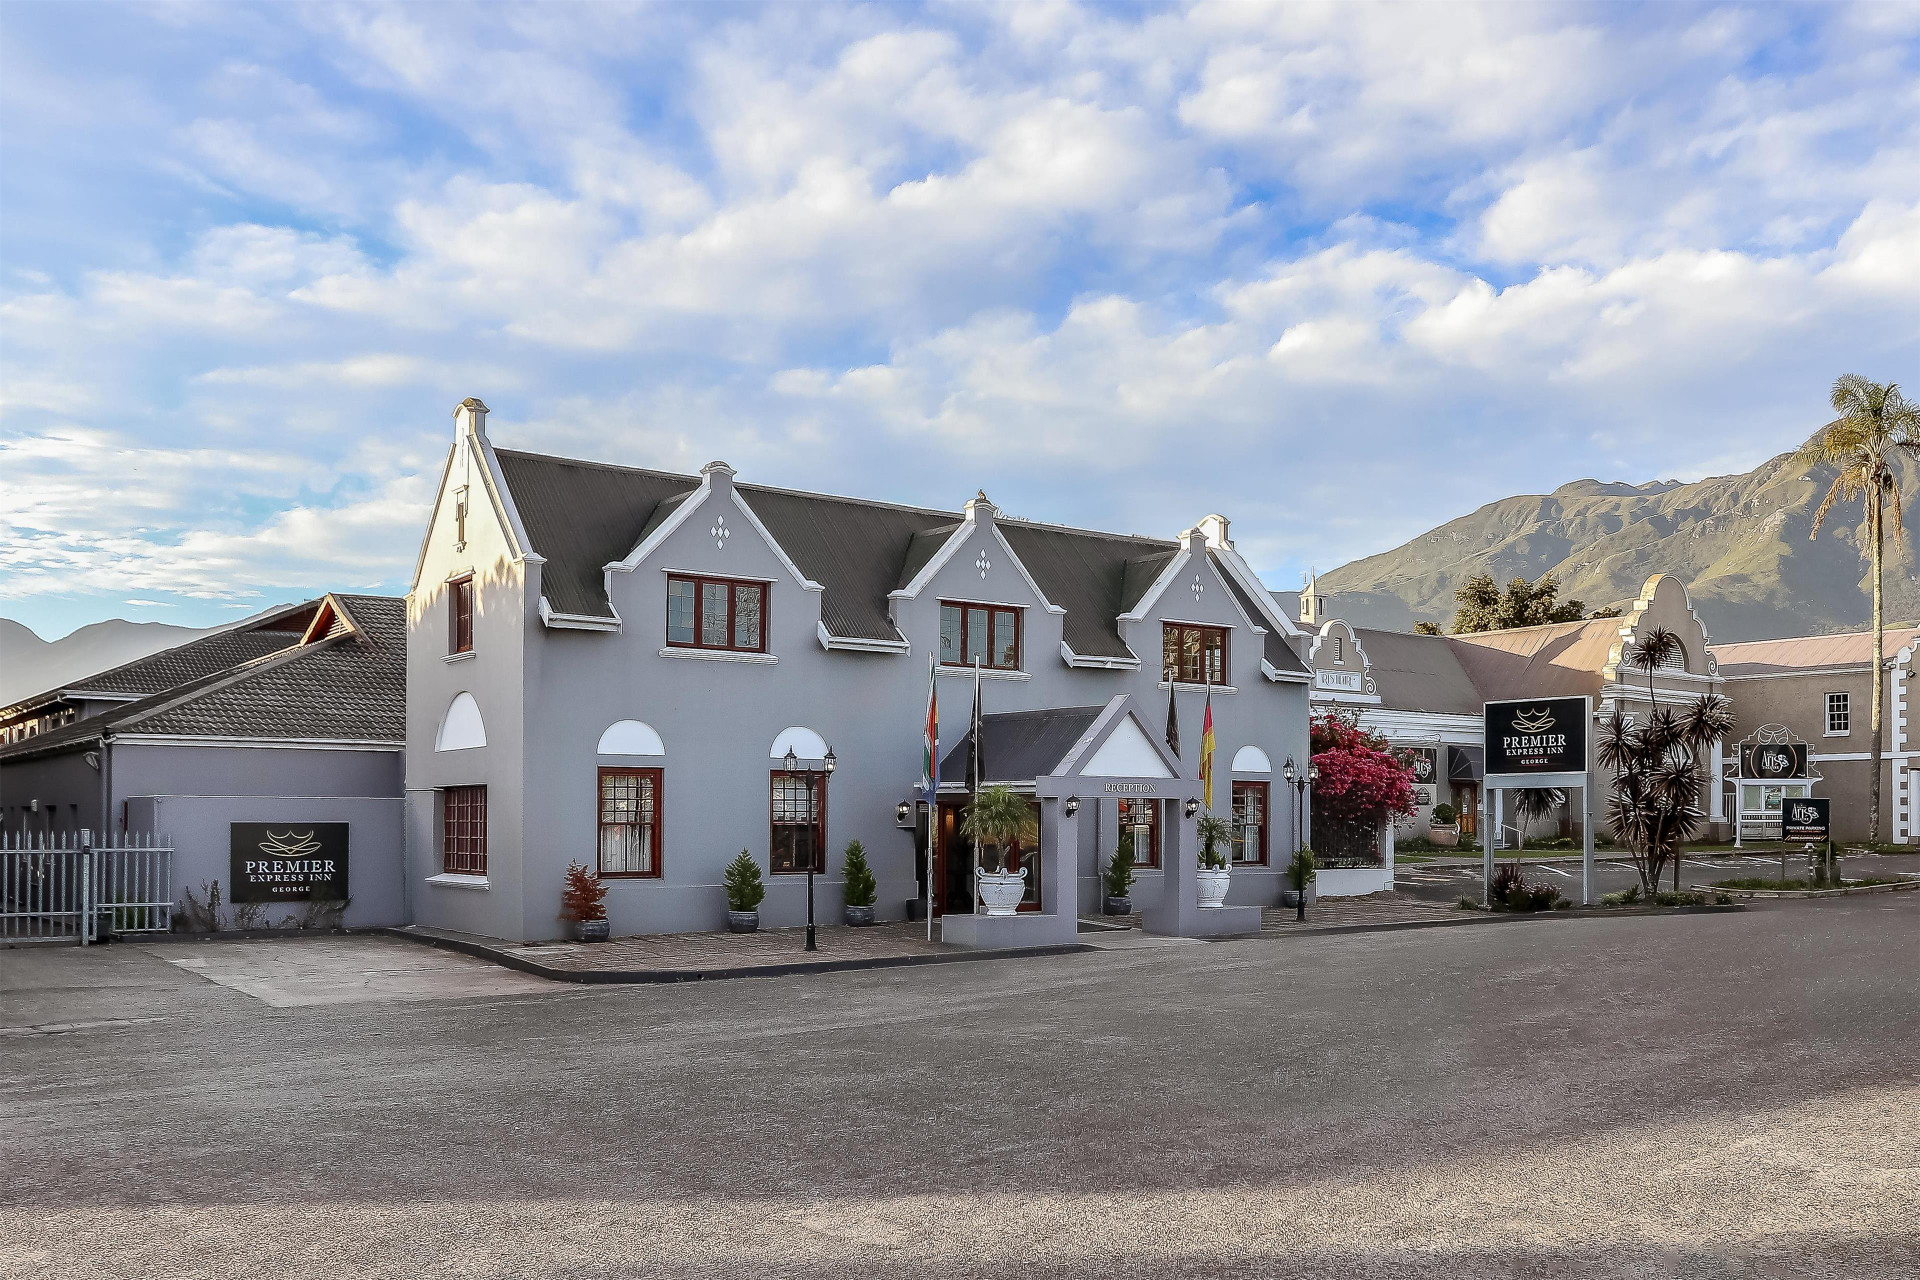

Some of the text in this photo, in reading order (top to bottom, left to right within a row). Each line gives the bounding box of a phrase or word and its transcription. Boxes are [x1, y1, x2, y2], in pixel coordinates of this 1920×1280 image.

[1503, 734, 1566, 748] PREMIER
[1104, 783, 1156, 792] RECEPTION
[245, 860, 336, 873] PREMIER
[250, 874, 304, 882] EXPRESS
